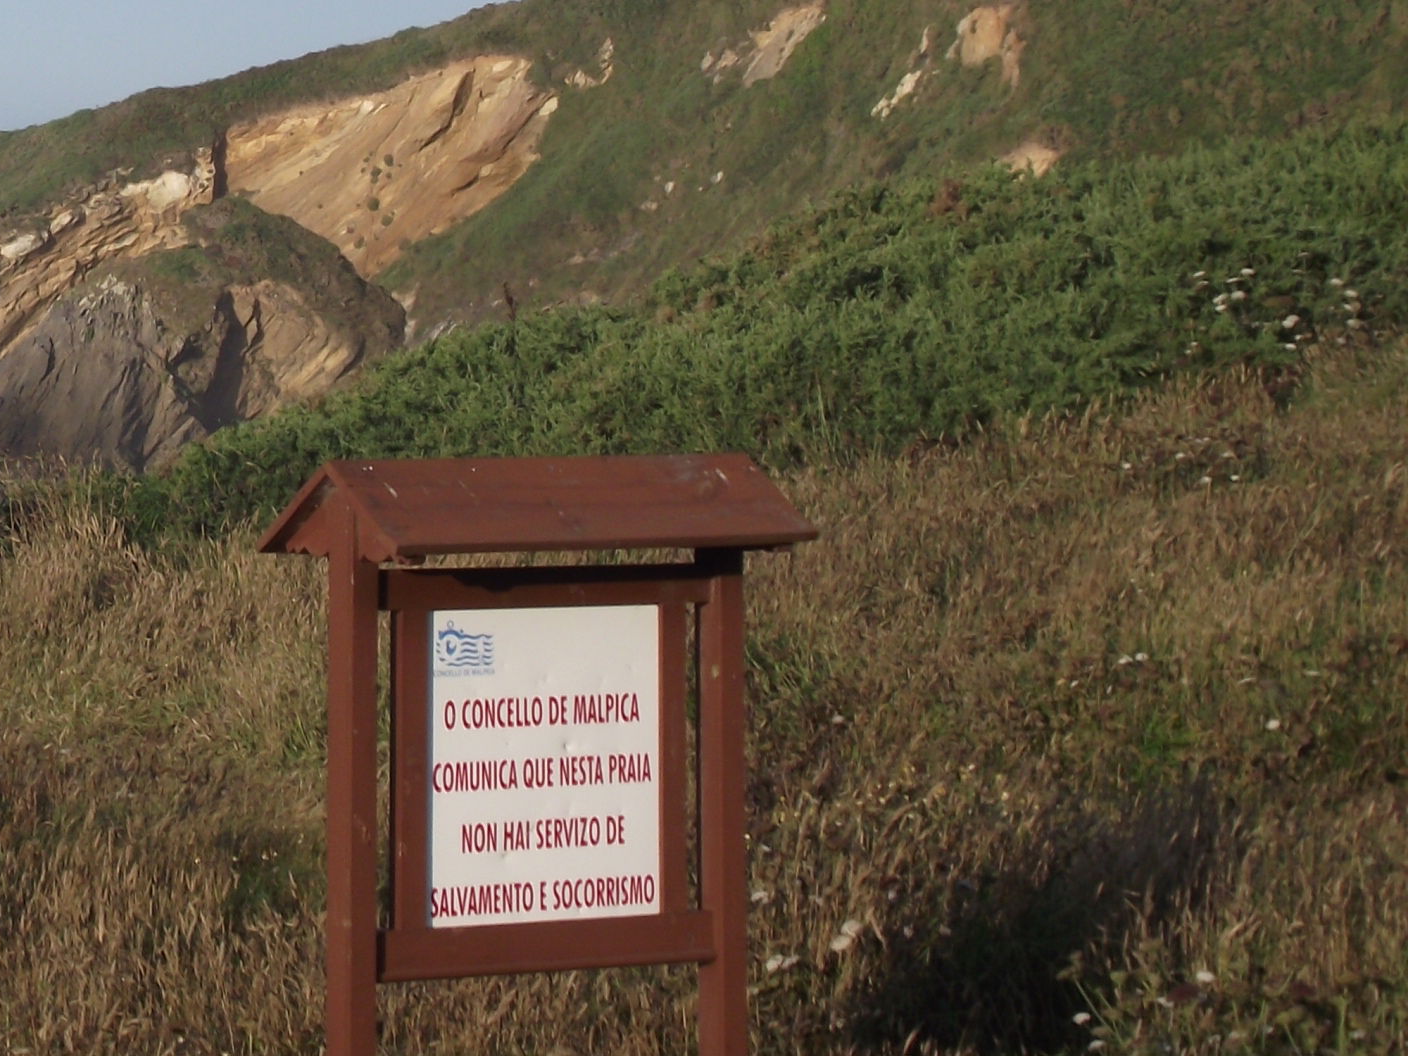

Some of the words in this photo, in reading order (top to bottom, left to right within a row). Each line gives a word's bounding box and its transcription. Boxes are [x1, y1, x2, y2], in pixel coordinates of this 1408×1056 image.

[444, 700, 456, 730] O
[461, 696, 543, 730] CONCELLO
[548, 695, 568, 726] DE
[573, 692, 640, 725] MALPICA
[433, 759, 518, 793] COMUNICA
[522, 757, 554, 790] QUE
[559, 755, 604, 787] NESTA
[608, 752, 652, 784] PRAIA
[461, 822, 498, 854] NON
[503, 820, 531, 852] HAI
[535, 816, 601, 850] SERVIZO
[606, 815, 625, 845] DE
[431, 882, 534, 918] SALVAMENTO
[539, 881, 548, 911] E
[552, 874, 655, 911] SOCORRISMO
